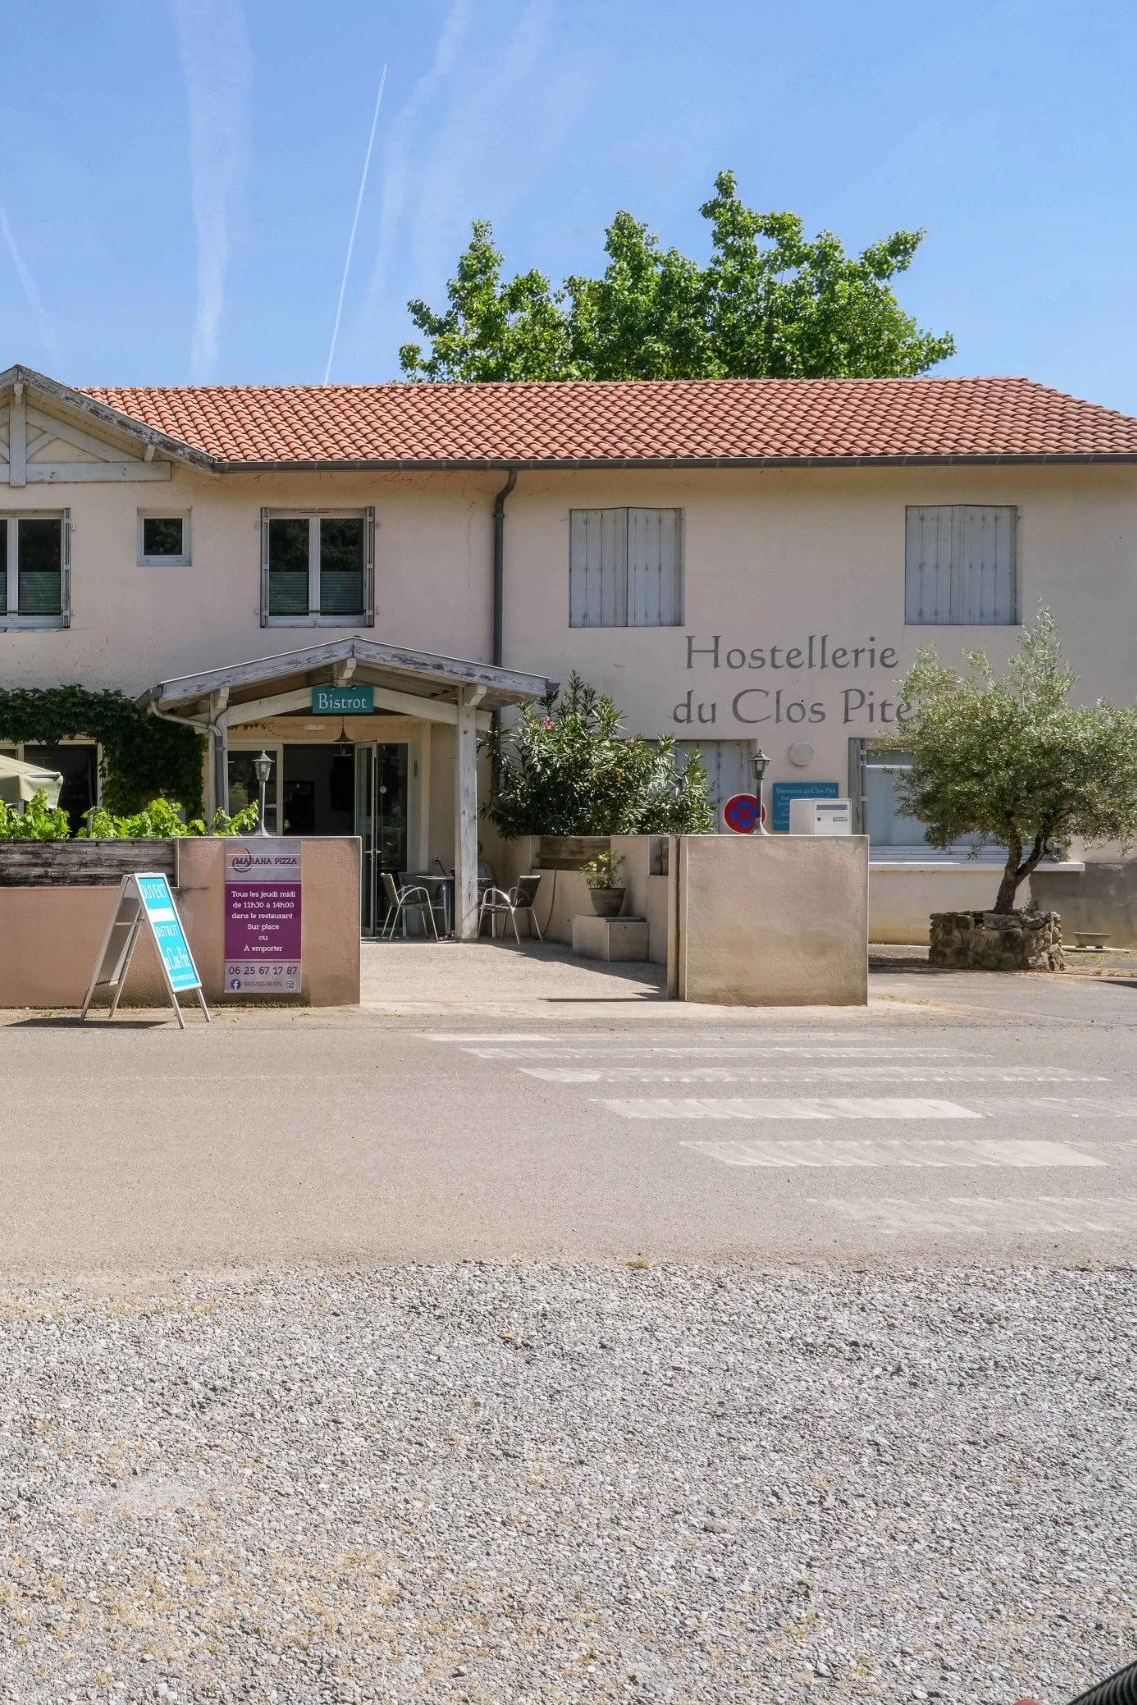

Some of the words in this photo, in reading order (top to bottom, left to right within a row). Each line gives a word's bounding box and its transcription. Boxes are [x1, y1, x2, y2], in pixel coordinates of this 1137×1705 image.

[685, 635, 899, 670] Hostellerie
[318, 693, 368, 709] Bistrot
[672, 690, 717, 724] du
[732, 688, 826, 724] Clos
[275, 857, 297, 865] PIZZA
[260, 891, 278, 899] jeudi
[280, 890, 296, 898] midi
[262, 923, 280, 931] place
[228, 966, 241, 975] 06
[244, 966, 256, 975] 25
[258, 966, 270, 975] 67
[273, 966, 284, 975] 17
